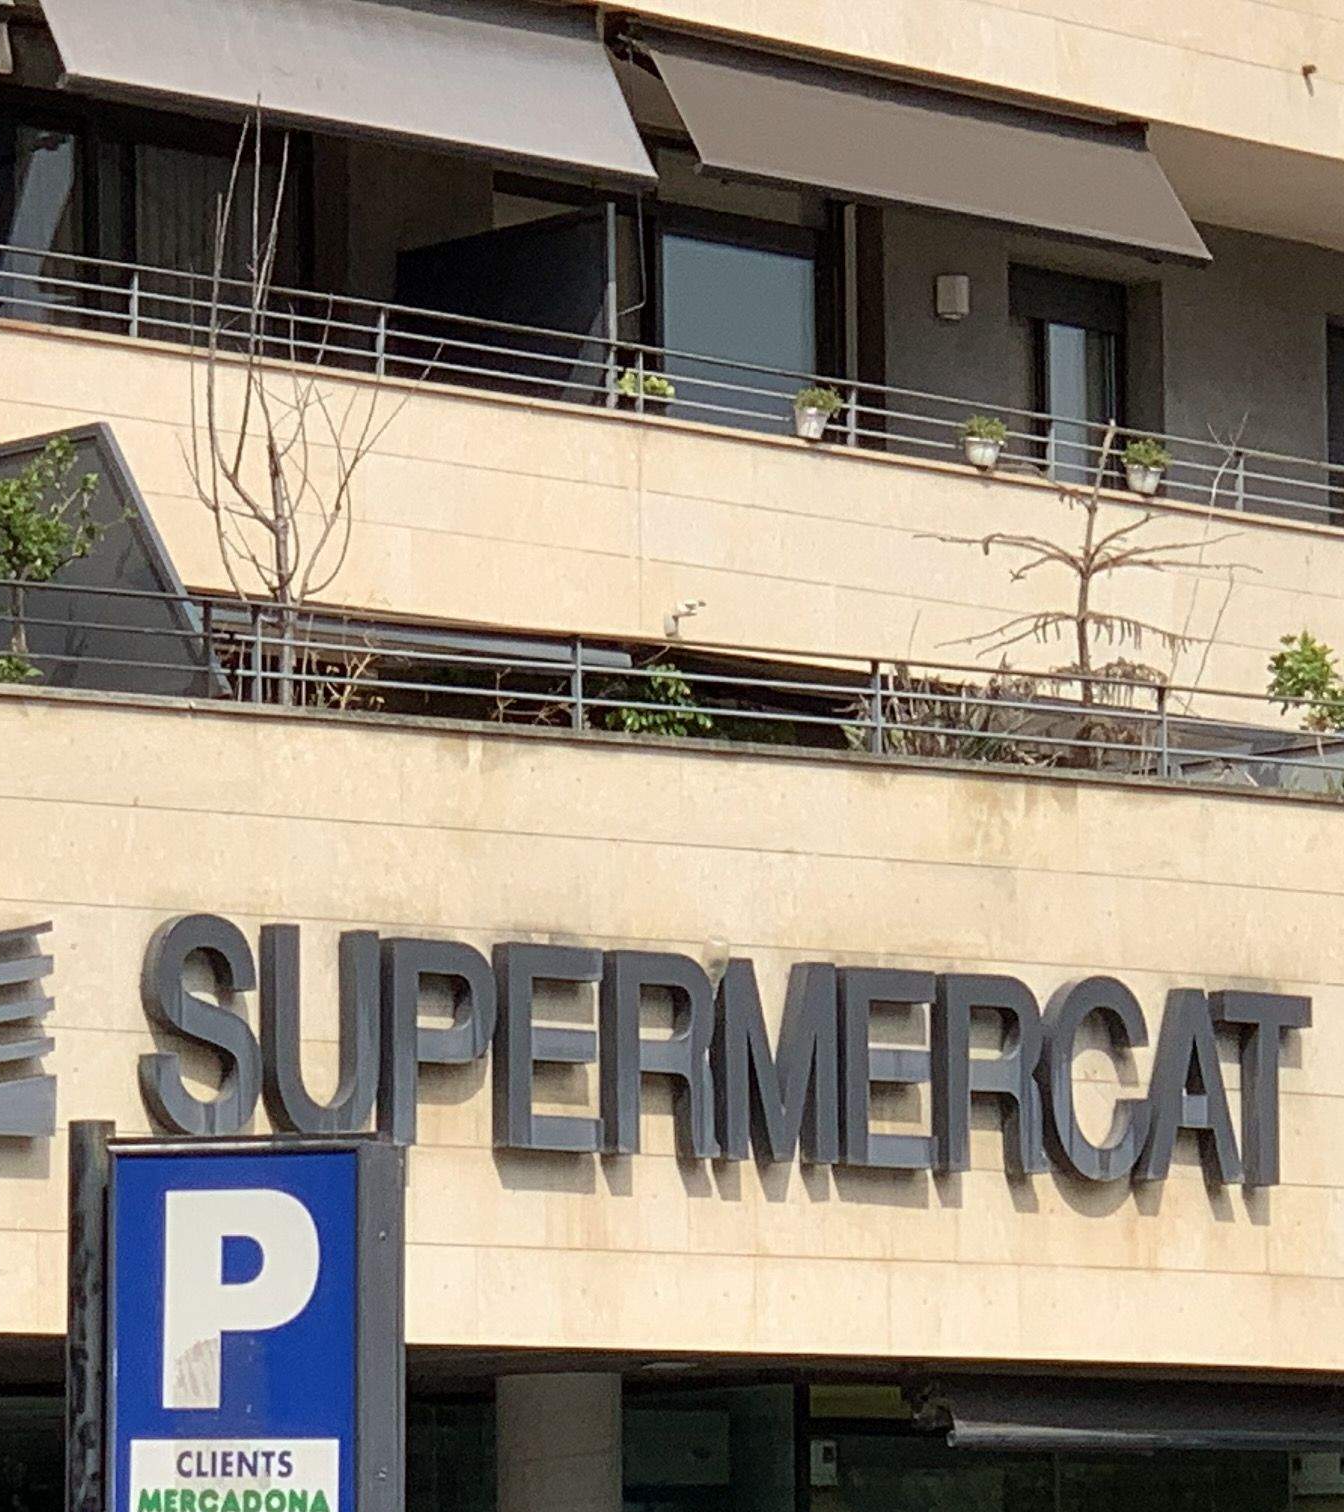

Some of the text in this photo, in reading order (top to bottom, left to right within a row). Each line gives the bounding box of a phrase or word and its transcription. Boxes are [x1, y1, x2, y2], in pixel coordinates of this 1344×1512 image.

[138, 912, 1313, 1187] SUPERMERCAT
[162, 1188, 322, 1410] P
[176, 1450, 294, 1479] CLIENTS
